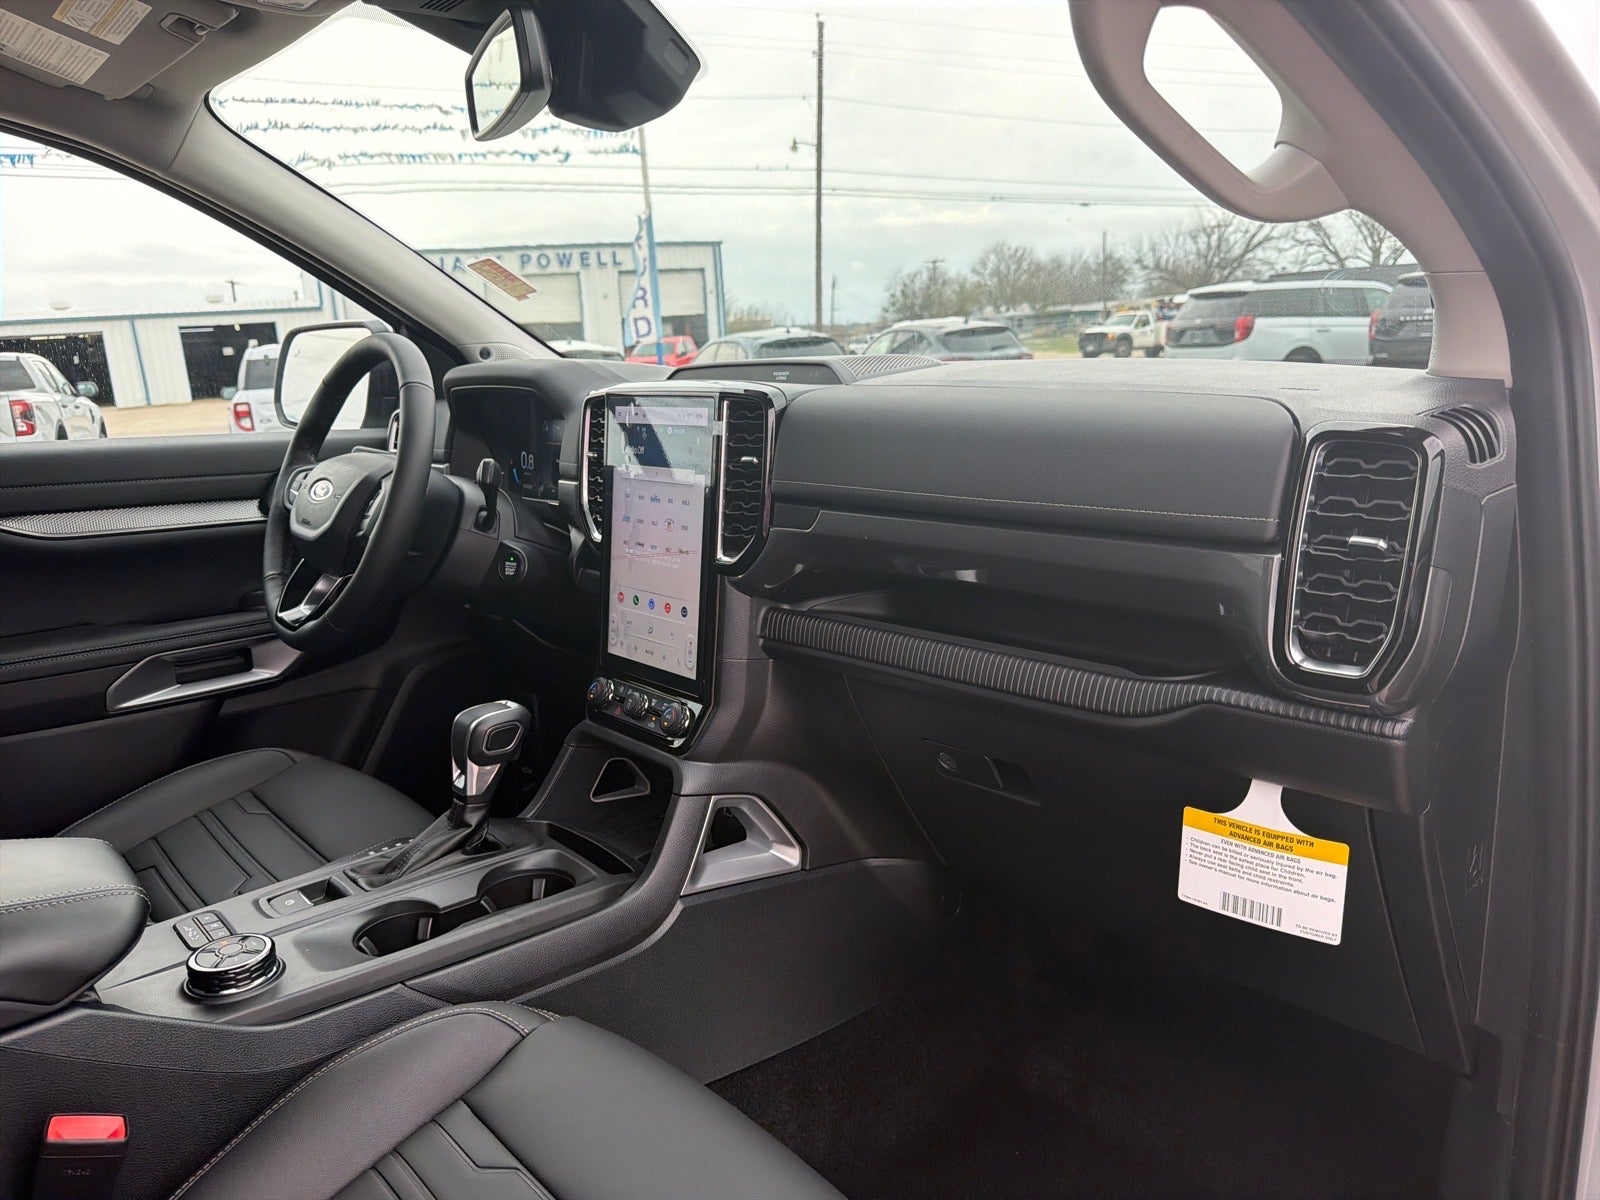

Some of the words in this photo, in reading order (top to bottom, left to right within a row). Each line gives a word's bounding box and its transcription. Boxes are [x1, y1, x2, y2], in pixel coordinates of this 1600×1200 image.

[520, 250, 623, 270] POWELL
[520, 451, 535, 470] 0.8
[1213, 818, 1227, 826] THIS
[1228, 822, 1253, 834] VEHICLE
[1262, 831, 1294, 844] EQUIPPED
[1296, 838, 1314, 848] WITH
[1229, 830, 1262, 844] ADVANCED
[1276, 843, 1294, 852] BAGS
[1190, 837, 1210, 846] Children
[1229, 847, 1242, 856] killed
[1250, 853, 1274, 866] seriously
[1276, 860, 1296, 870] injured
[1190, 848, 1202, 856] Never
[1228, 860, 1244, 869] facing
[1245, 864, 1258, 872] child
[1248, 847, 1274, 858] ADVANCED
[1189, 854, 1206, 863] Always
[1252, 872, 1266, 880] child
[1239, 856, 1254, 865] safest
[1255, 861, 1270, 869] place
[1280, 868, 1306, 878] Children.
[1198, 863, 1218, 872] owner's
[1218, 868, 1237, 877] manual
[1246, 876, 1260, 886] more
[1260, 882, 1292, 893] information
[1320, 896, 1336, 904] bags.
